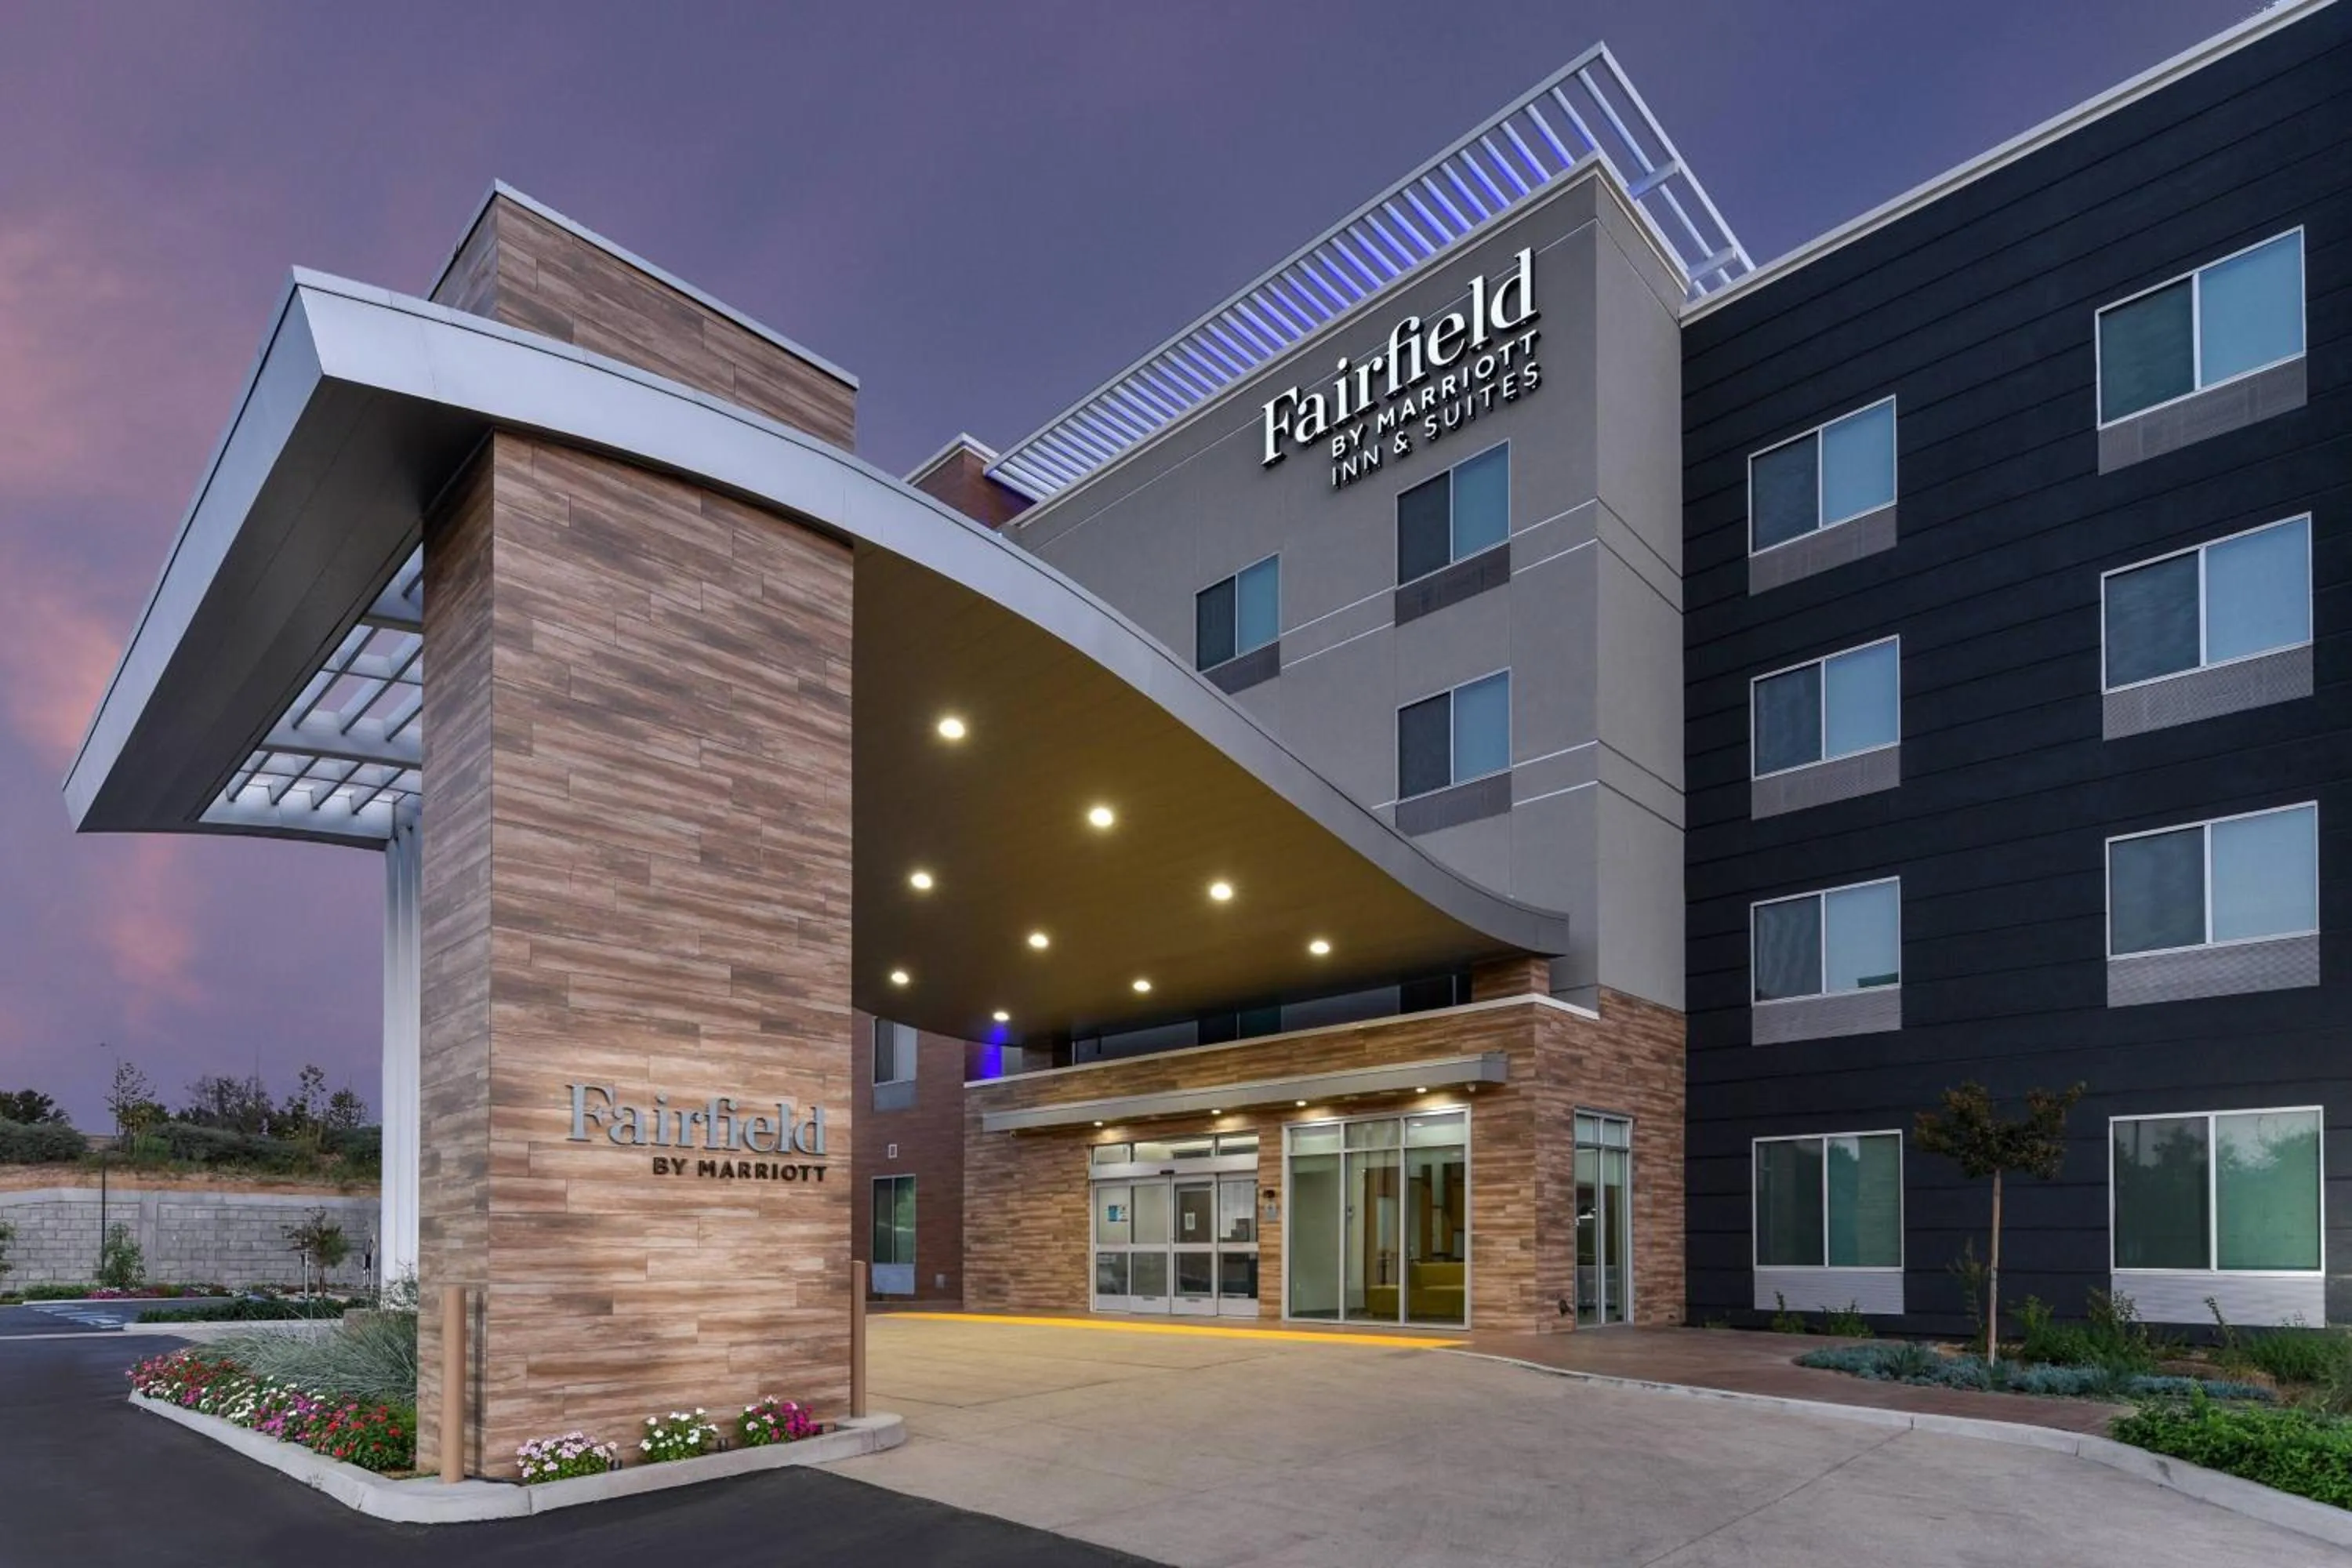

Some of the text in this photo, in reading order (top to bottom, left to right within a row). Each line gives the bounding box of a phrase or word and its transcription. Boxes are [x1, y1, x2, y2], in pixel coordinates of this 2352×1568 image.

[1261, 247, 1538, 466] Fairfield
[1333, 330, 1540, 459] BY MARRIOTT
[1333, 361, 1540, 486] INN & SUITES
[565, 1083, 826, 1155] Fairfield
[652, 1156, 827, 1182] BY MARRIOTT
